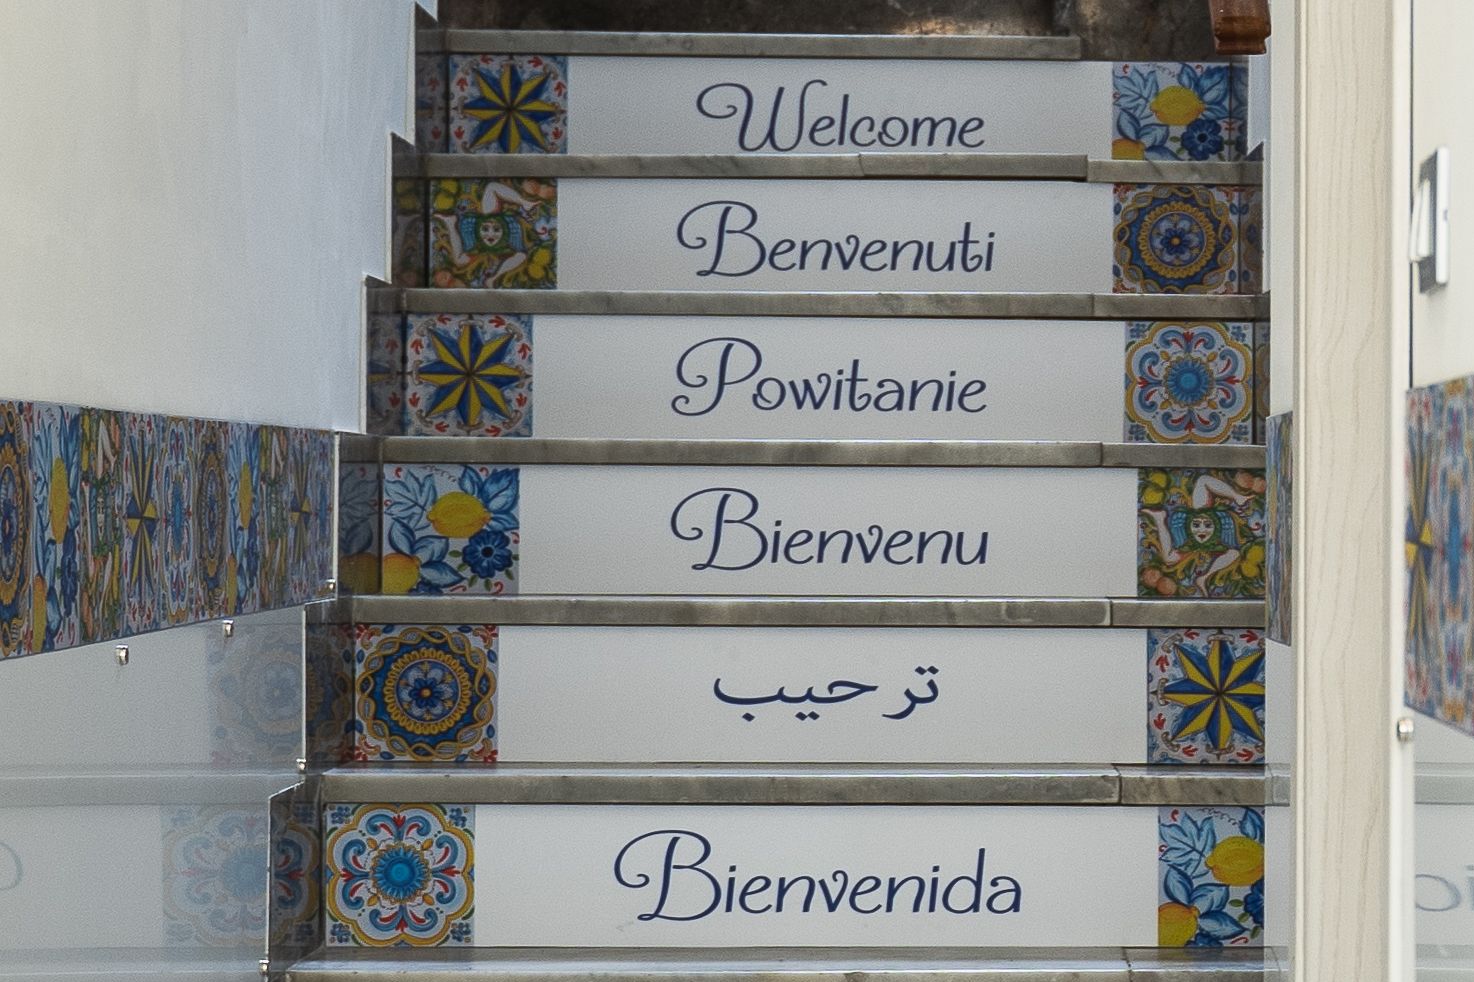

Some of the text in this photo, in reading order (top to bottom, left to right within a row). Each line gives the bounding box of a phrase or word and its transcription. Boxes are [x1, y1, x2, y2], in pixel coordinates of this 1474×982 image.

[695, 79, 985, 151] Welcome
[676, 200, 996, 278] Benvenuti
[670, 336, 987, 417] Powitanie
[670, 487, 989, 571] Bienvenu
[713, 665, 940, 723] ترحيب
[613, 829, 1022, 922] Bienvenida
